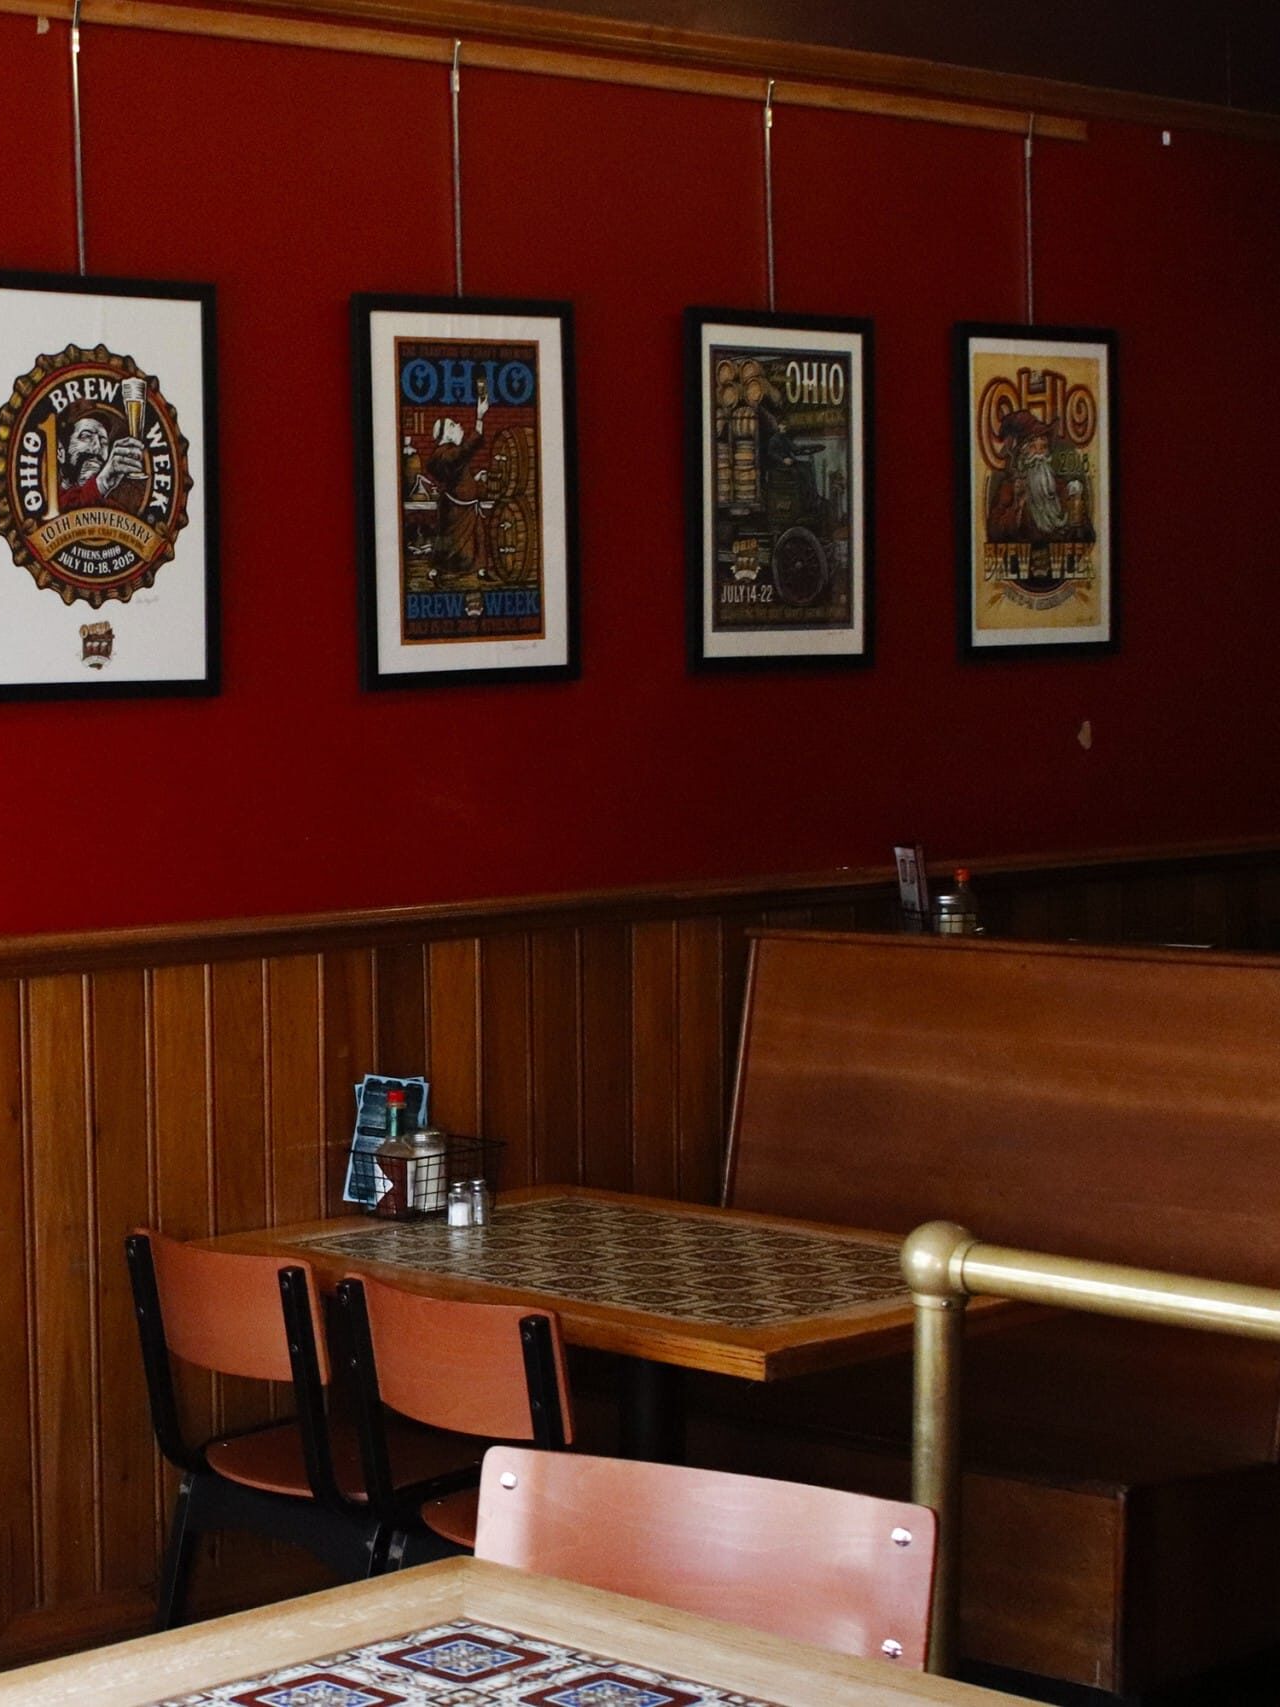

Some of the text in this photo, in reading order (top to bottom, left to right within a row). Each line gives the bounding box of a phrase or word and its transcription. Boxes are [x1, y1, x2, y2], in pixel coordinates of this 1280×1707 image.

[401, 358, 535, 405] OHIO
[785, 361, 844, 405] OHIO
[978, 367, 1098, 474] OHIO
[20, 377, 171, 514] OHIO BREW WEEK
[41, 511, 153, 544] 10TH ANNIVERSARY
[58, 551, 136, 574] JULY 10-18, 2015
[406, 591, 540, 620] BREW WEEK
[721, 584, 773, 603] JULY 14-22
